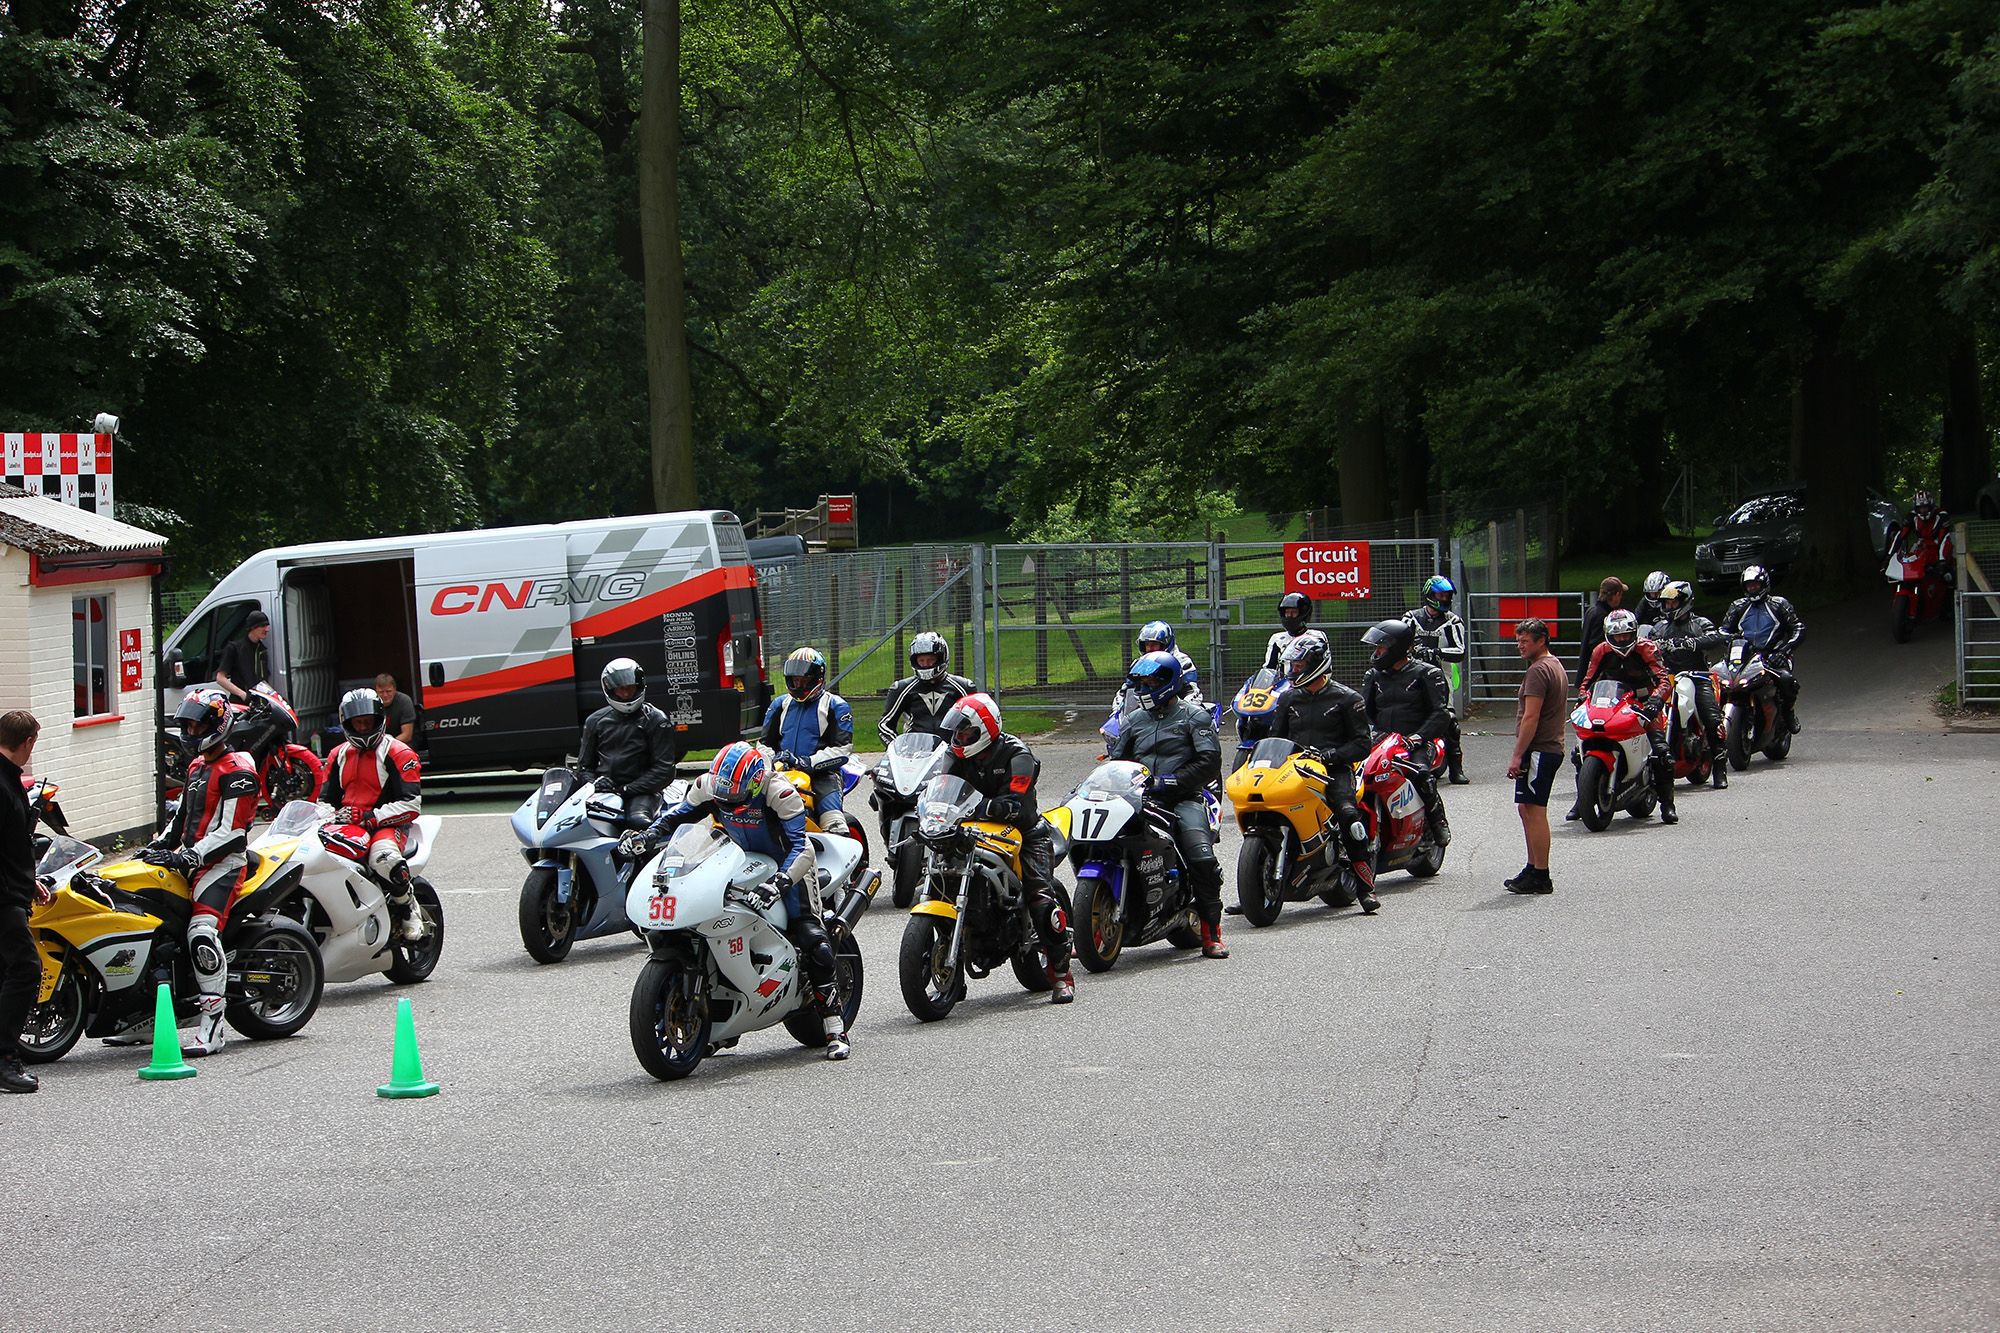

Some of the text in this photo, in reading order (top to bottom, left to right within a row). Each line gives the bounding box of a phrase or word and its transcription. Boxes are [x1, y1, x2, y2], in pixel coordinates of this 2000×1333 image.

[1296, 546, 1358, 563] Circuit
[1295, 566, 1359, 585] Closed
[126, 634, 134, 646] No
[121, 648, 141, 663] Smoking
[126, 663, 137, 676] Area
[1242, 692, 1269, 708] 33
[1253, 774, 1264, 787] 7
[1391, 783, 1414, 813] FILA
[1081, 808, 1110, 839] 17
[649, 896, 676, 920] 58
[729, 936, 744, 955] 58
